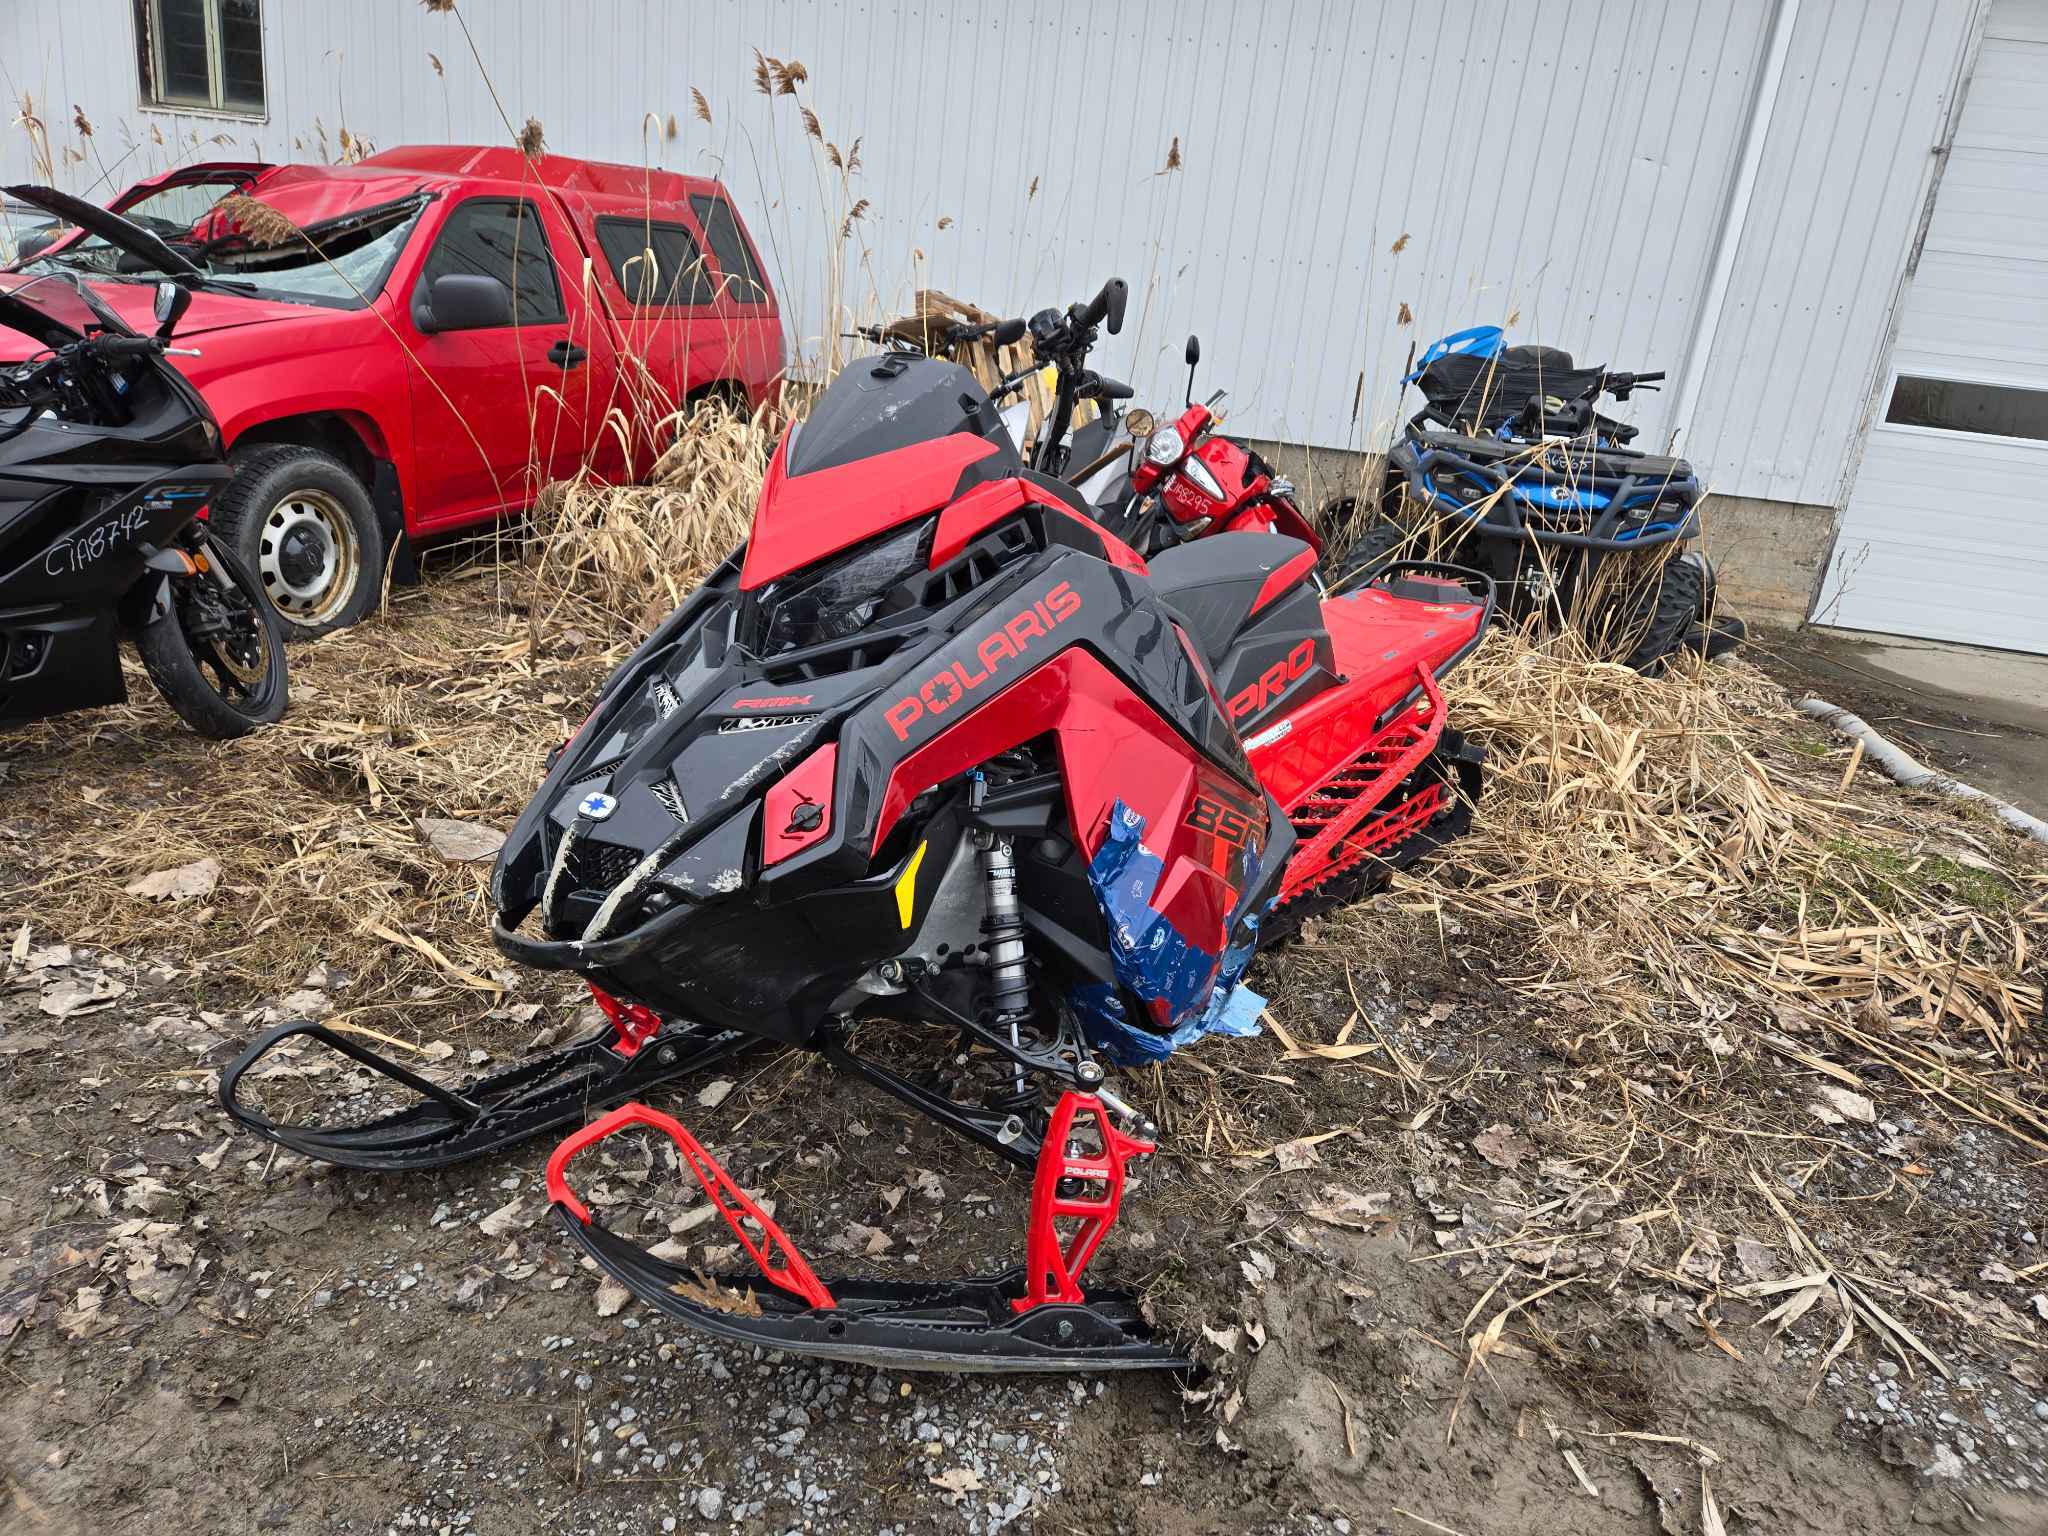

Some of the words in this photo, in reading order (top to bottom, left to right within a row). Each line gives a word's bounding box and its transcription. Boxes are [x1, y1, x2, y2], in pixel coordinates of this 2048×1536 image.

[45, 505, 150, 576] CIA8742
[883, 581, 1082, 742] POLARIS
[1224, 638, 1316, 722] PRO
[1064, 1165, 1109, 1178] POLARIS
